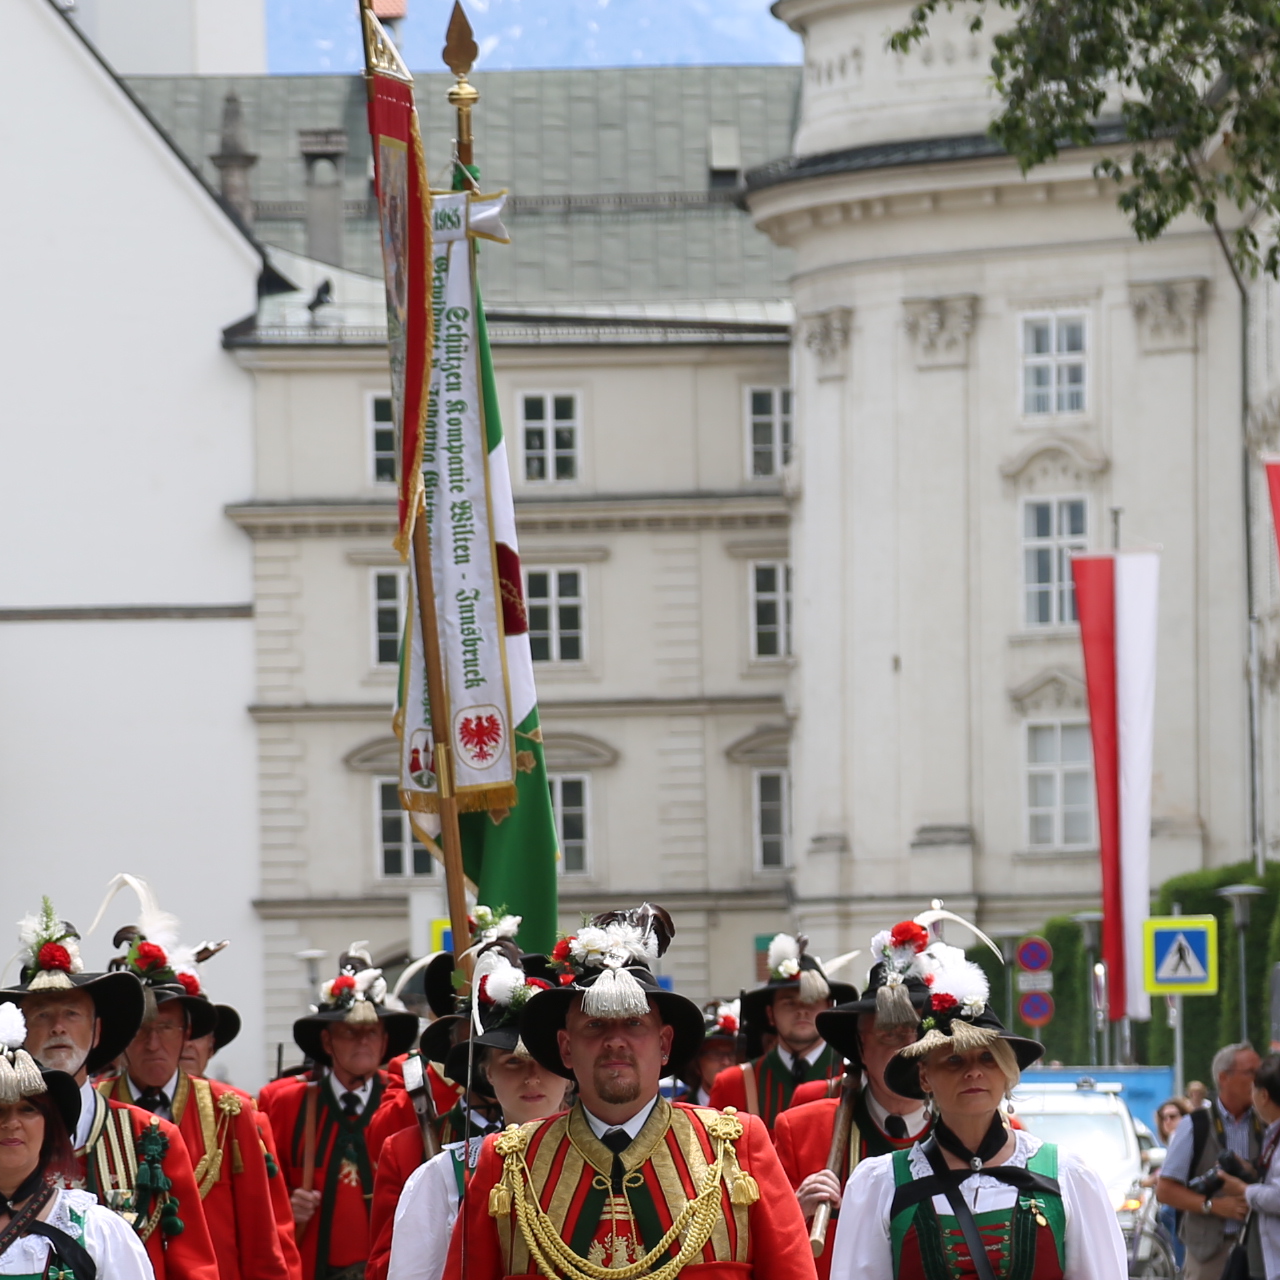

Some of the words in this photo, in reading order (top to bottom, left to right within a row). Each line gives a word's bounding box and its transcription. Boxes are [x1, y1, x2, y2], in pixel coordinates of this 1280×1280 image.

[433, 207, 461, 231] 1985
[440, 305, 471, 393] Schützen
[440, 398, 471, 494] Kompanie
[450, 500, 477, 566] Wilten
[455, 587, 488, 690] Innsbruck
